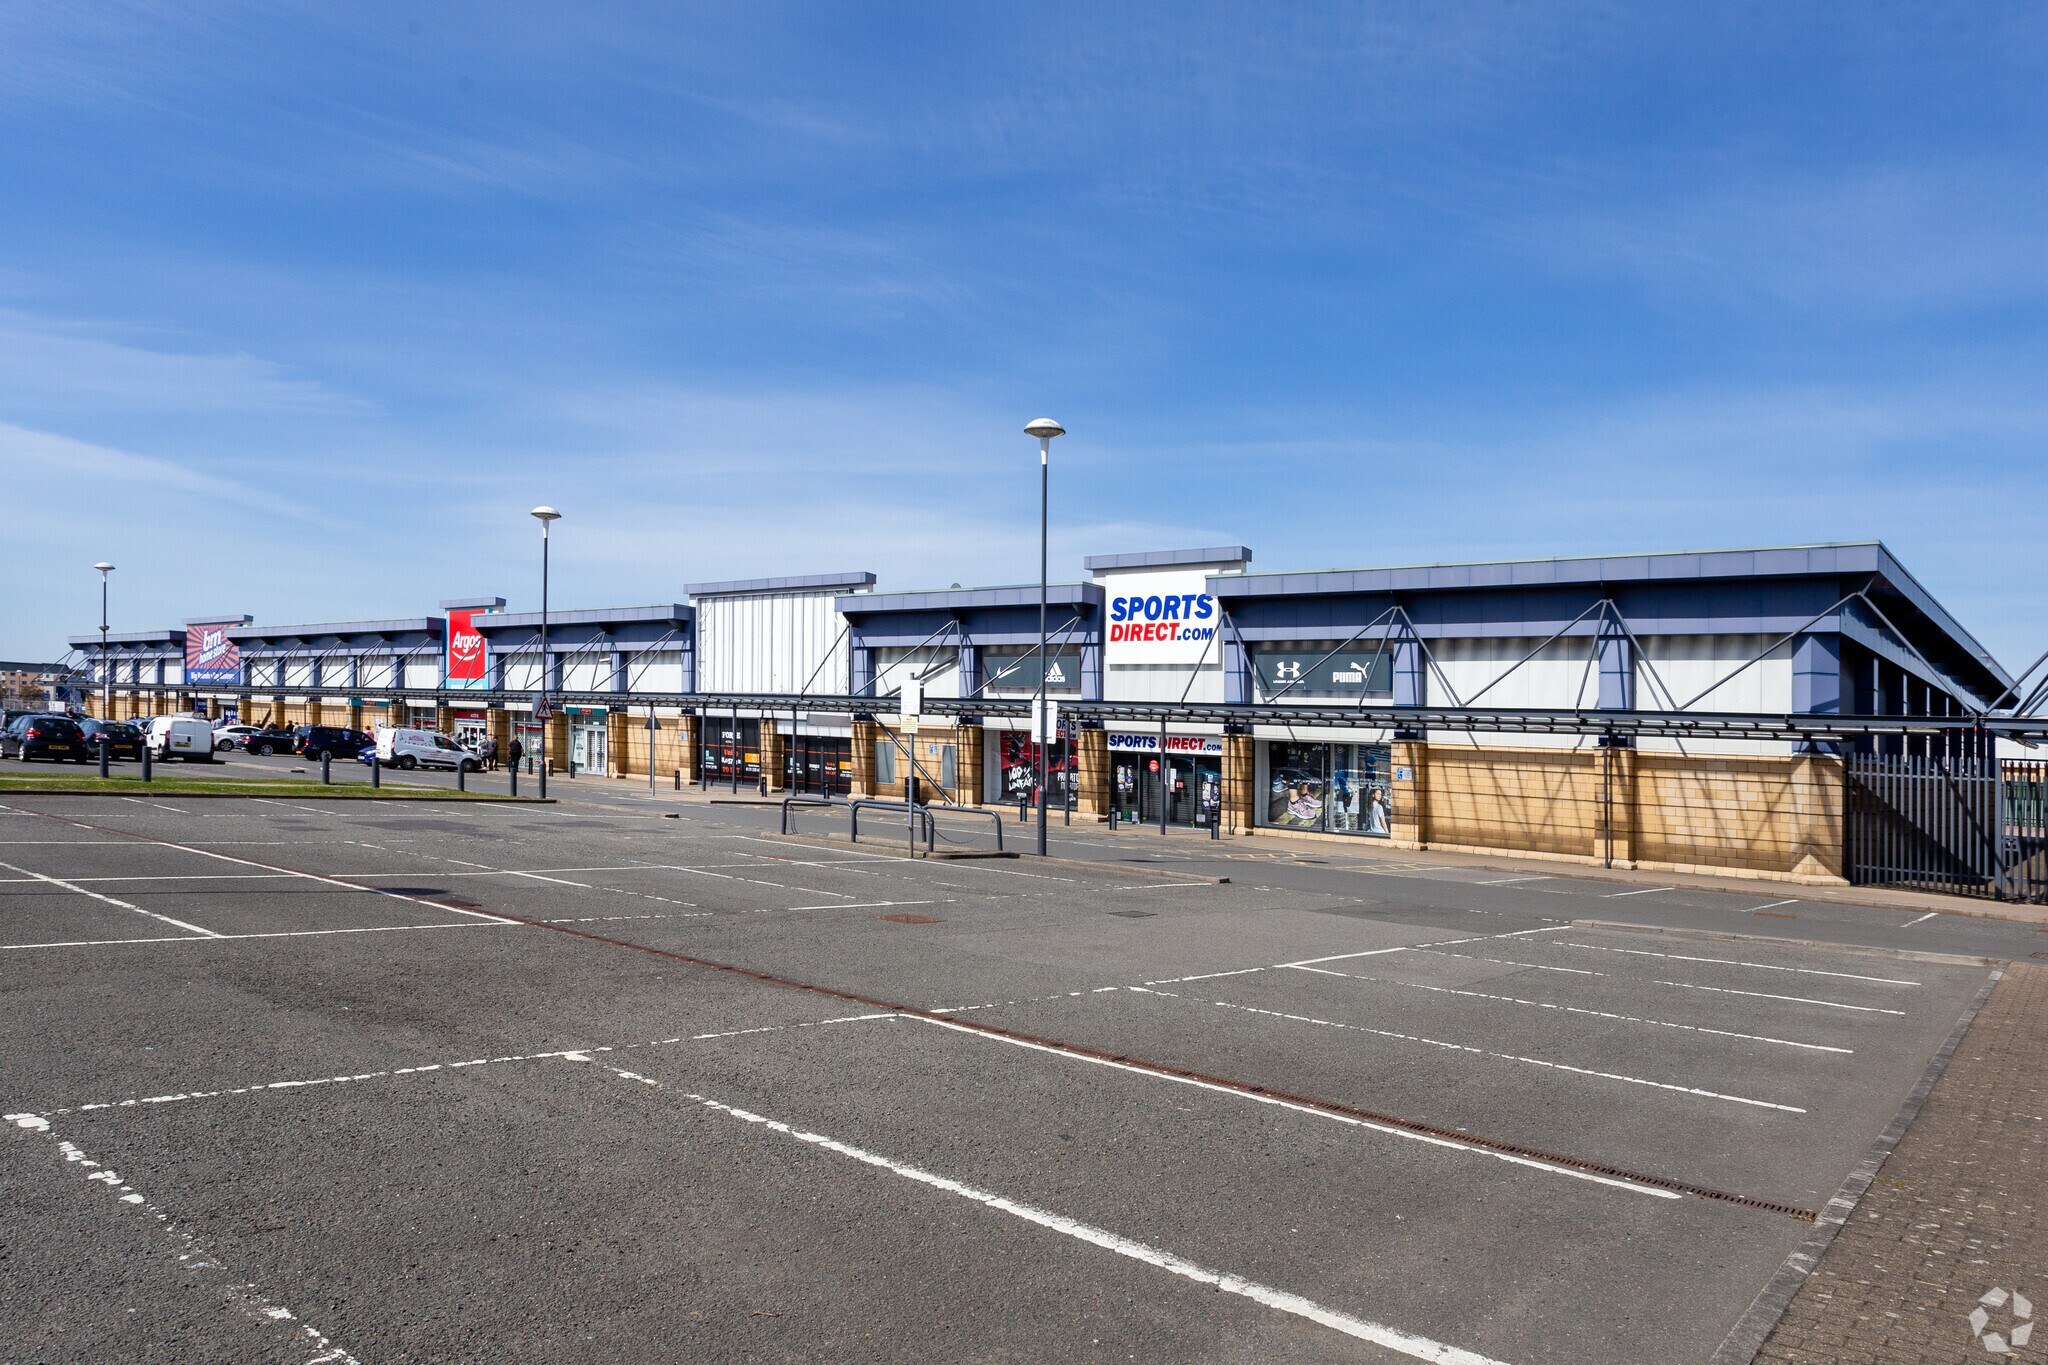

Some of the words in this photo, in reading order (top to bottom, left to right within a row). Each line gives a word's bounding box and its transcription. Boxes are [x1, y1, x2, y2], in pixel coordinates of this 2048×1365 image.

[1110, 593, 1214, 622] SPORTS
[1110, 622, 1214, 642] DIRECT.COM
[452, 631, 481, 653] Argos
[1332, 671, 1362, 683] PUMA
[722, 731, 741, 740] FORE
[1109, 734, 1157, 749] SPORTS
